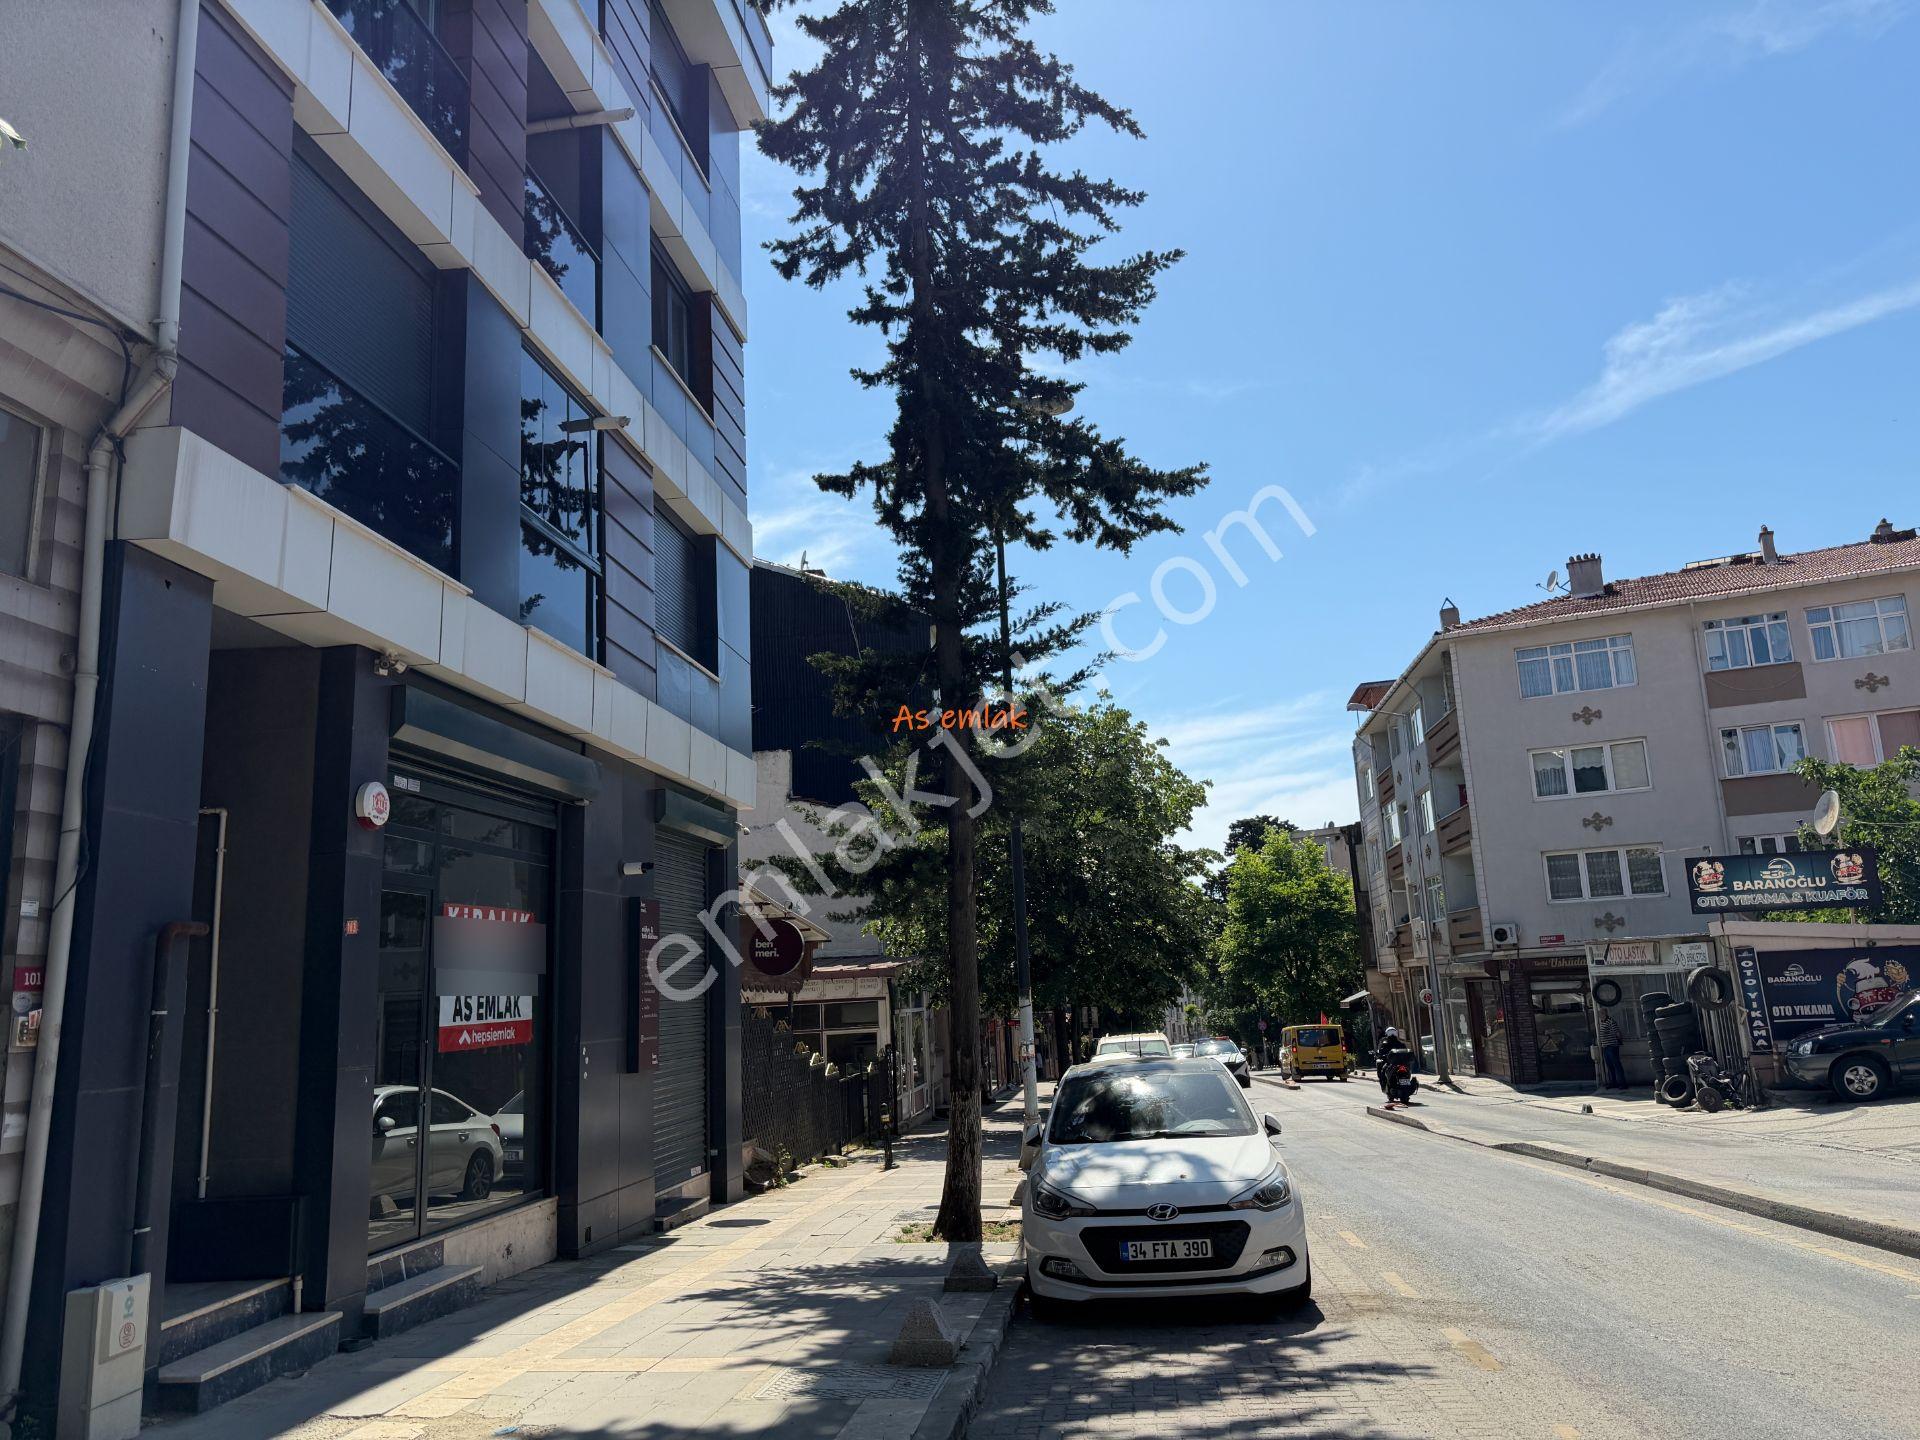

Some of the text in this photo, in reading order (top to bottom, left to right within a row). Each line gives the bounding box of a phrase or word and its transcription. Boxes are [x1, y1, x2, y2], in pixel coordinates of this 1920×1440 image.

[1733, 875, 1827, 891] BARANOĞLU
[1697, 887, 1869, 908] OTO YIKAMA & KUAFÖR
[755, 938, 774, 948] ben
[1609, 946, 1622, 960] OTO
[24, 972, 42, 985] 101
[1741, 960, 1757, 986] OTO
[1767, 974, 1822, 984] BARANOĞLU
[453, 996, 522, 1023] AS EMLAK
[1772, 1004, 1835, 1017] OTO YIKAMA
[1746, 992, 1768, 1046] YIKAMA
[472, 1026, 516, 1046] hepsiemlak
[1130, 1240, 1209, 1259] 34 FTA 390
